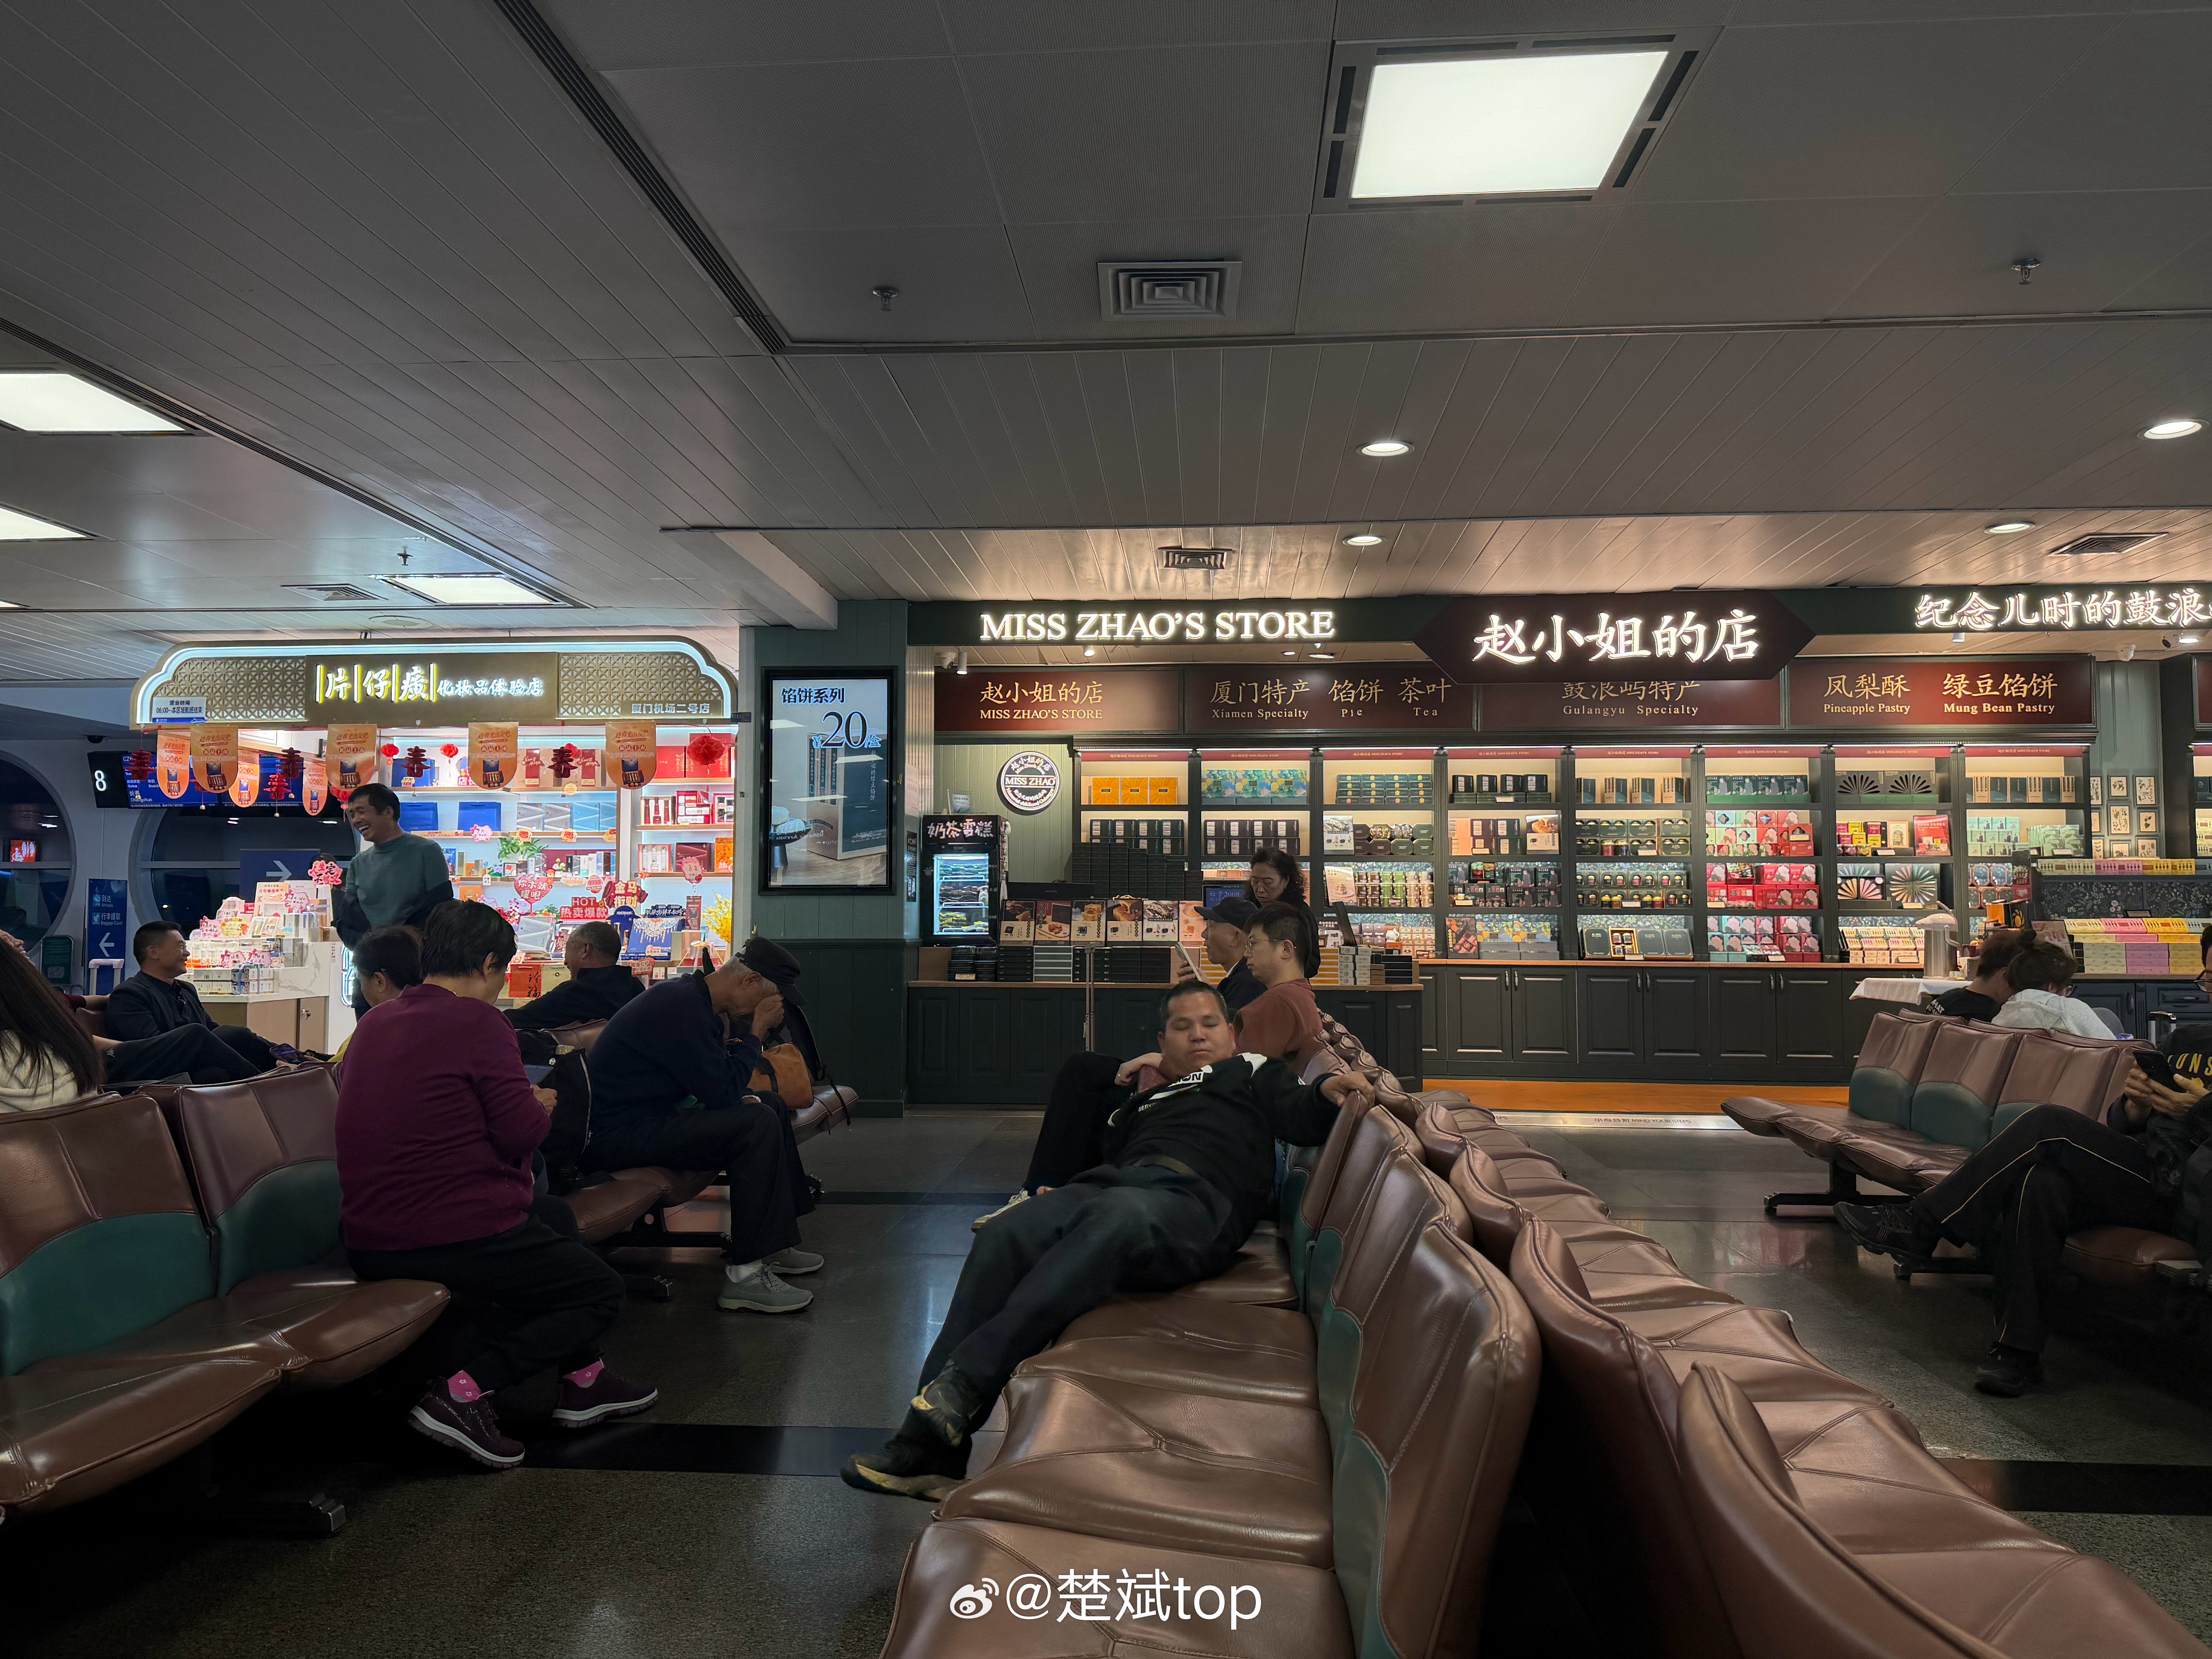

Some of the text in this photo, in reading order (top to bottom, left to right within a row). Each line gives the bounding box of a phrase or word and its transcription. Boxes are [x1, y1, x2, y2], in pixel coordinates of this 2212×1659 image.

[1915, 588, 2212, 629] 纪念儿时的鼓浪
[980, 613, 1066, 640] MISS
[1216, 611, 1334, 639] STORE
[1472, 609, 1759, 663] 赵小姐的店
[436, 678, 543, 696] 化妆品体验店
[980, 681, 1103, 704] 赵小姐的店
[1210, 678, 1451, 705] 厦门特产 馅饼 茶叶
[1562, 681, 1700, 701] 鼓浪屿特产
[1824, 673, 2058, 699] 凤梨酥 绿豆馅饼
[781, 687, 845, 704] 馅饼系列
[631, 703, 709, 714] 厦门机场二号店
[980, 709, 1011, 719] MISS
[1061, 709, 1103, 720] STORE
[1212, 708, 1437, 720] Xiamen Specialty Pie Tea
[1563, 705, 1698, 716] Gulangyu Specialty
[1824, 704, 1910, 714] Pineapple Pastry
[1944, 703, 2055, 714] Mung Bean Pastry
[1011, 756, 1051, 771] 赵小姐的店
[94, 770, 106, 791] 8
[1005, 777, 1027, 785] MISS
[927, 818, 994, 839] 奶茶雪糕
[615, 881, 637, 894] 金马
[572, 898, 595, 906] HOT
[561, 907, 608, 918] 热卖爆款
